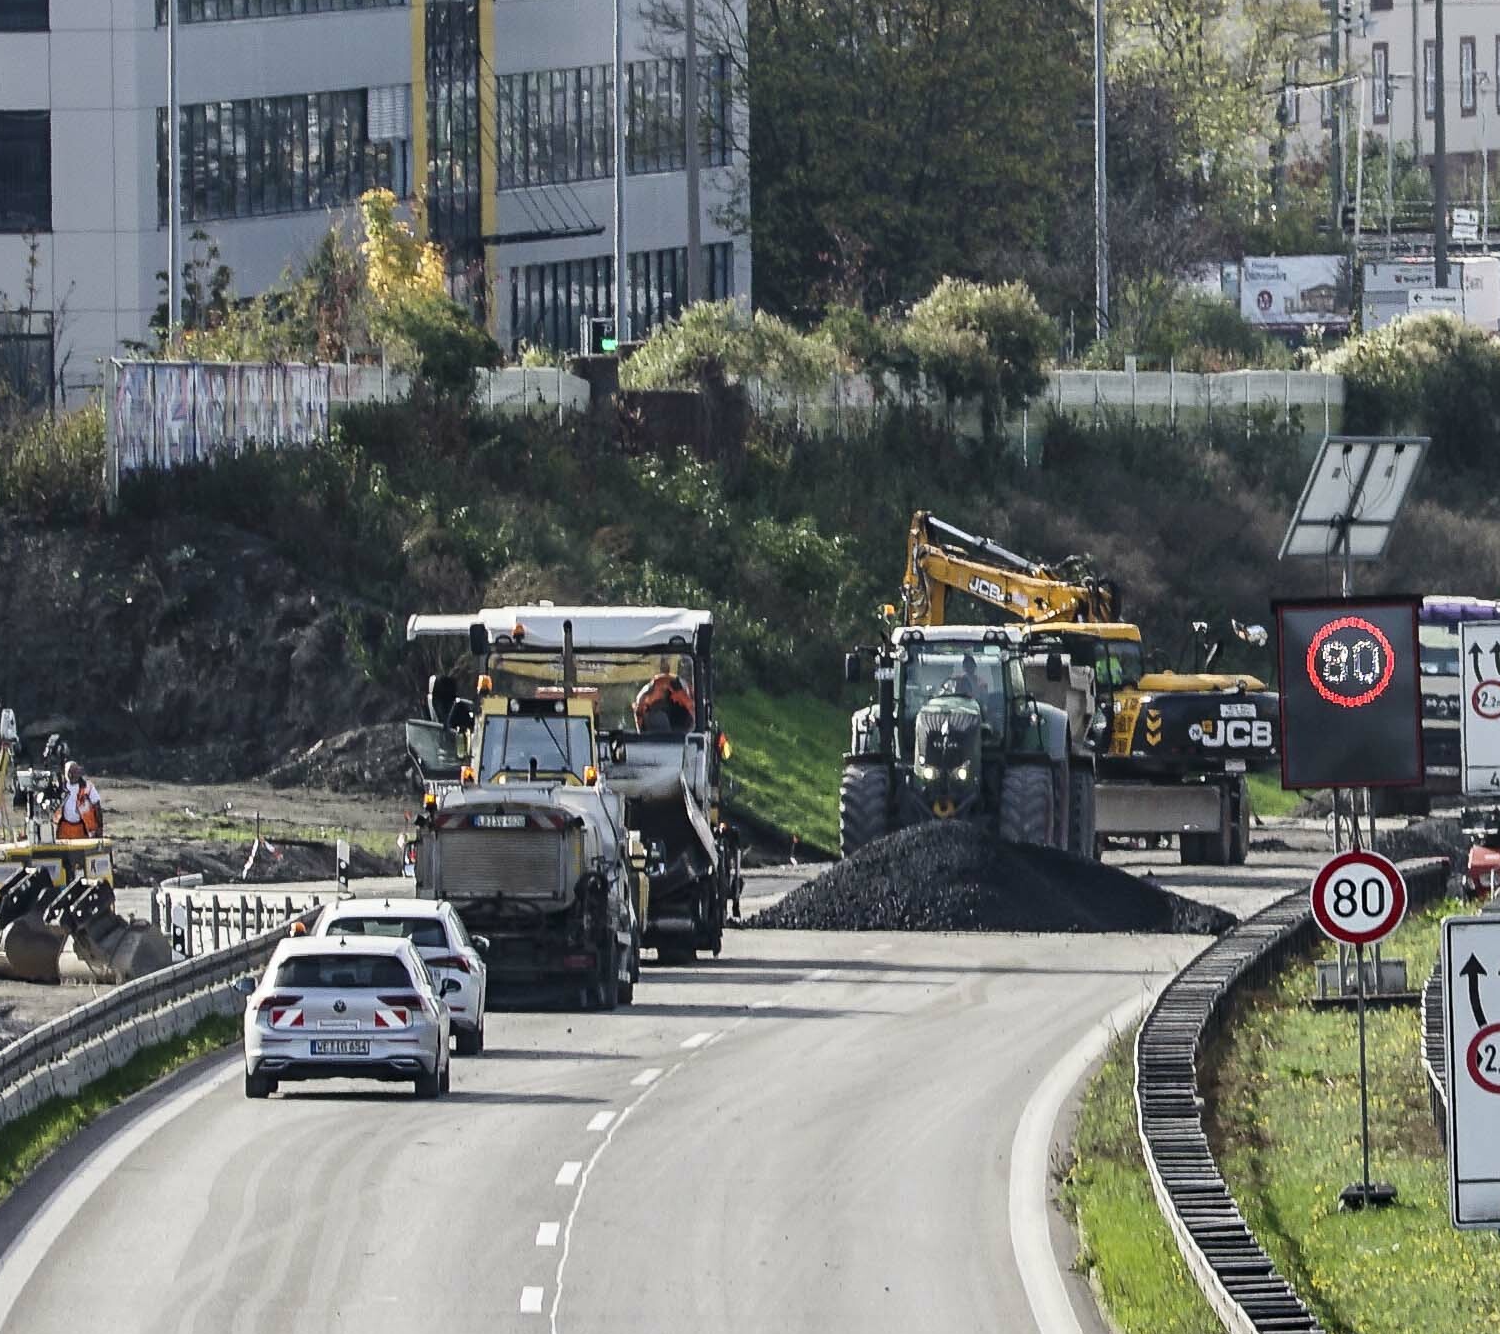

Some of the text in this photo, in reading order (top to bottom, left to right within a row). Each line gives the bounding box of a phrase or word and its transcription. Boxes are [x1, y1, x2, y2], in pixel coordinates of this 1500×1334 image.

[968, 576, 1002, 601] JCB
[1322, 640, 1380, 685] 80
[1425, 699, 1460, 709] MAN
[1201, 720, 1273, 748] JCB
[1333, 877, 1385, 918] 80
